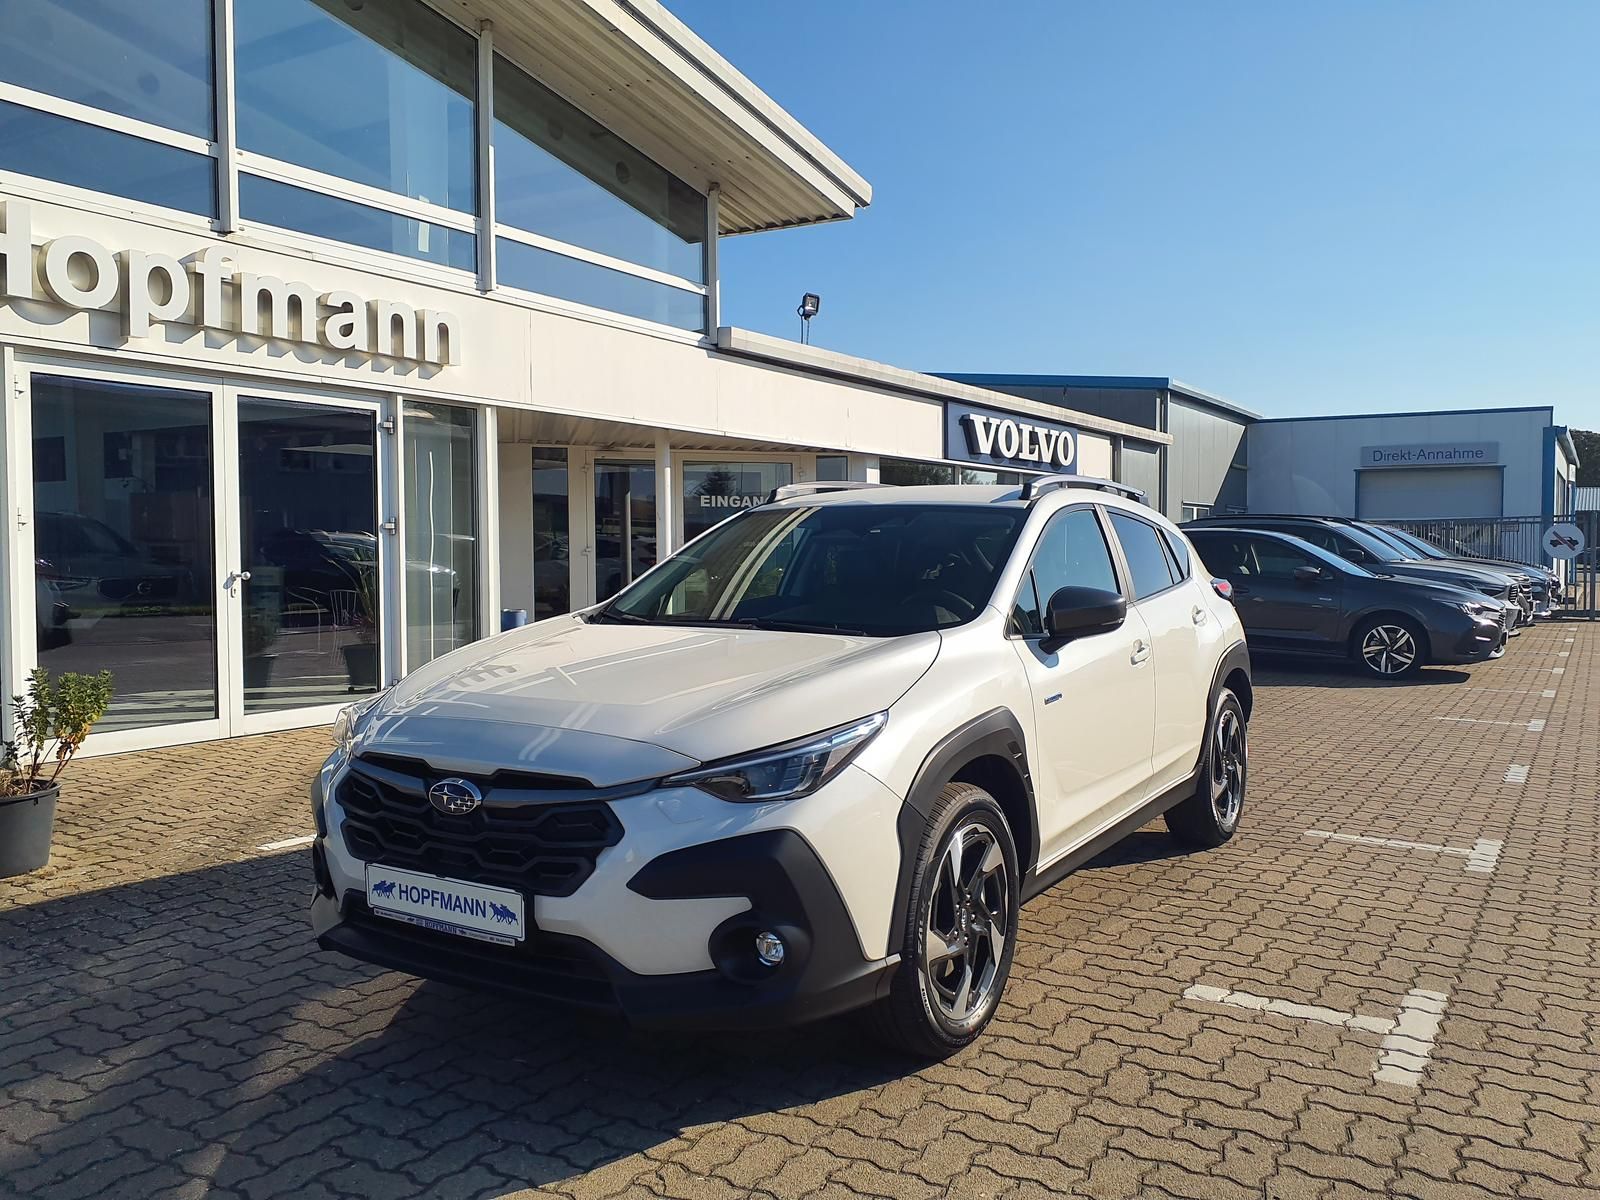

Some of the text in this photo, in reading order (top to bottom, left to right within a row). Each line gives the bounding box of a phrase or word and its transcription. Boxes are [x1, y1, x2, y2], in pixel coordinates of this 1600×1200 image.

[967, 413, 1075, 467] VOLVO
[1372, 447, 1485, 463] Direkt-Annahme
[700, 495, 768, 508] EINGAN
[398, 883, 487, 918] HOPFMANN
